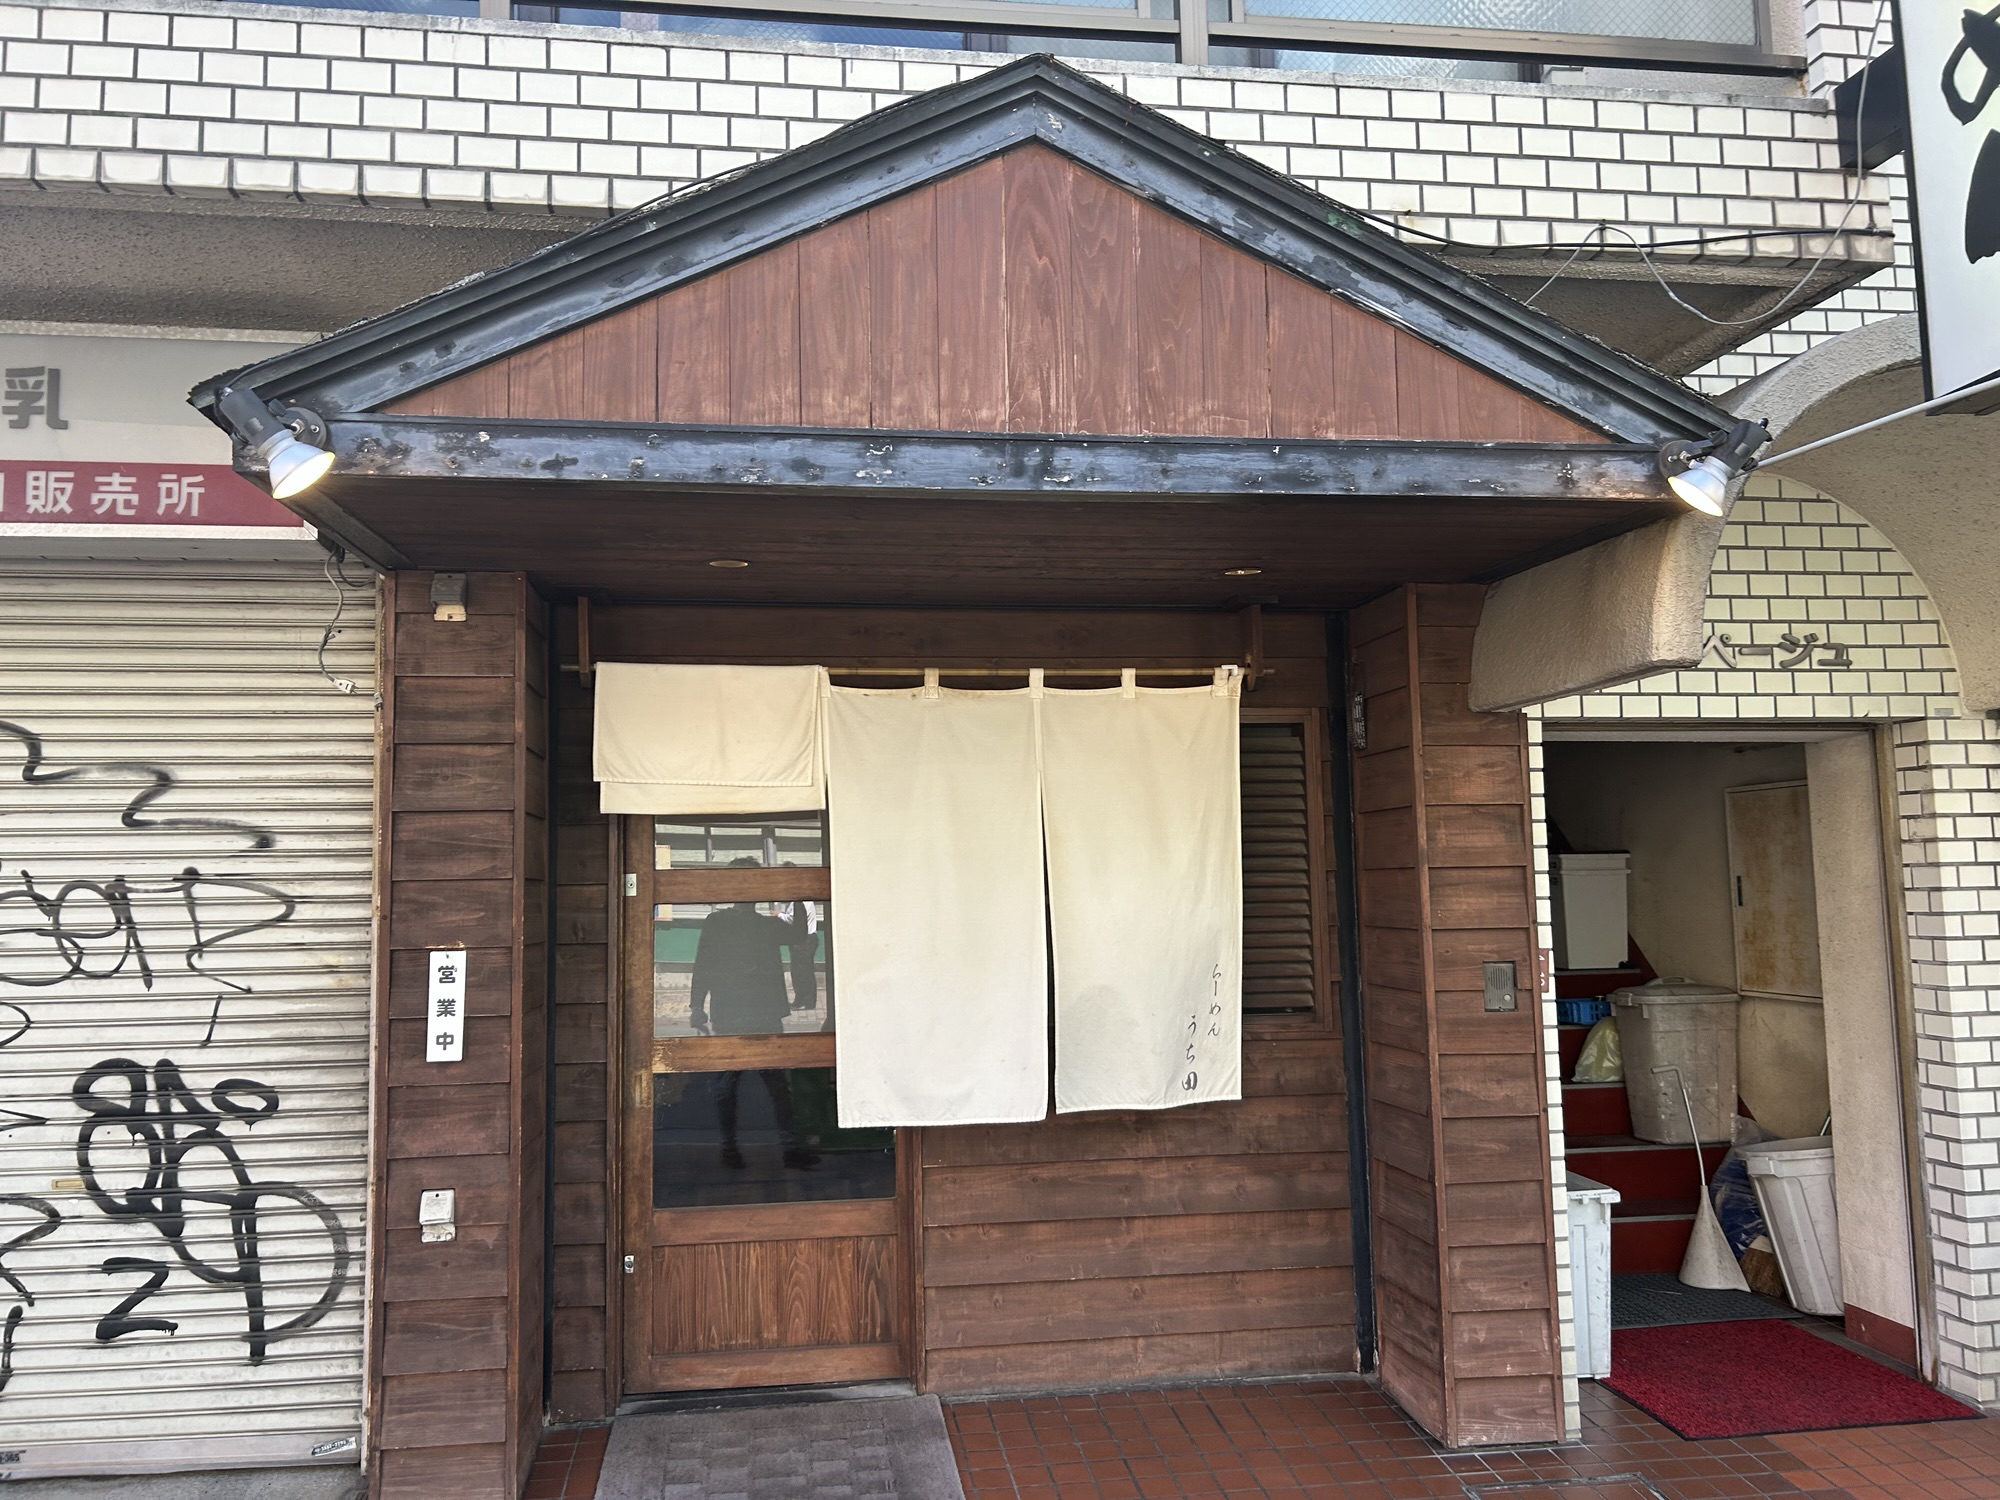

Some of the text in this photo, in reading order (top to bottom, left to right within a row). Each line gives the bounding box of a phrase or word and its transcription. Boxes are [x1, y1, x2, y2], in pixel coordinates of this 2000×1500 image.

[2, 366, 69, 430] 乳
[0, 470, 205, 517] 販売所
[436, 964, 457, 1051] 営業中
[1207, 963, 1222, 1037] らーめん
